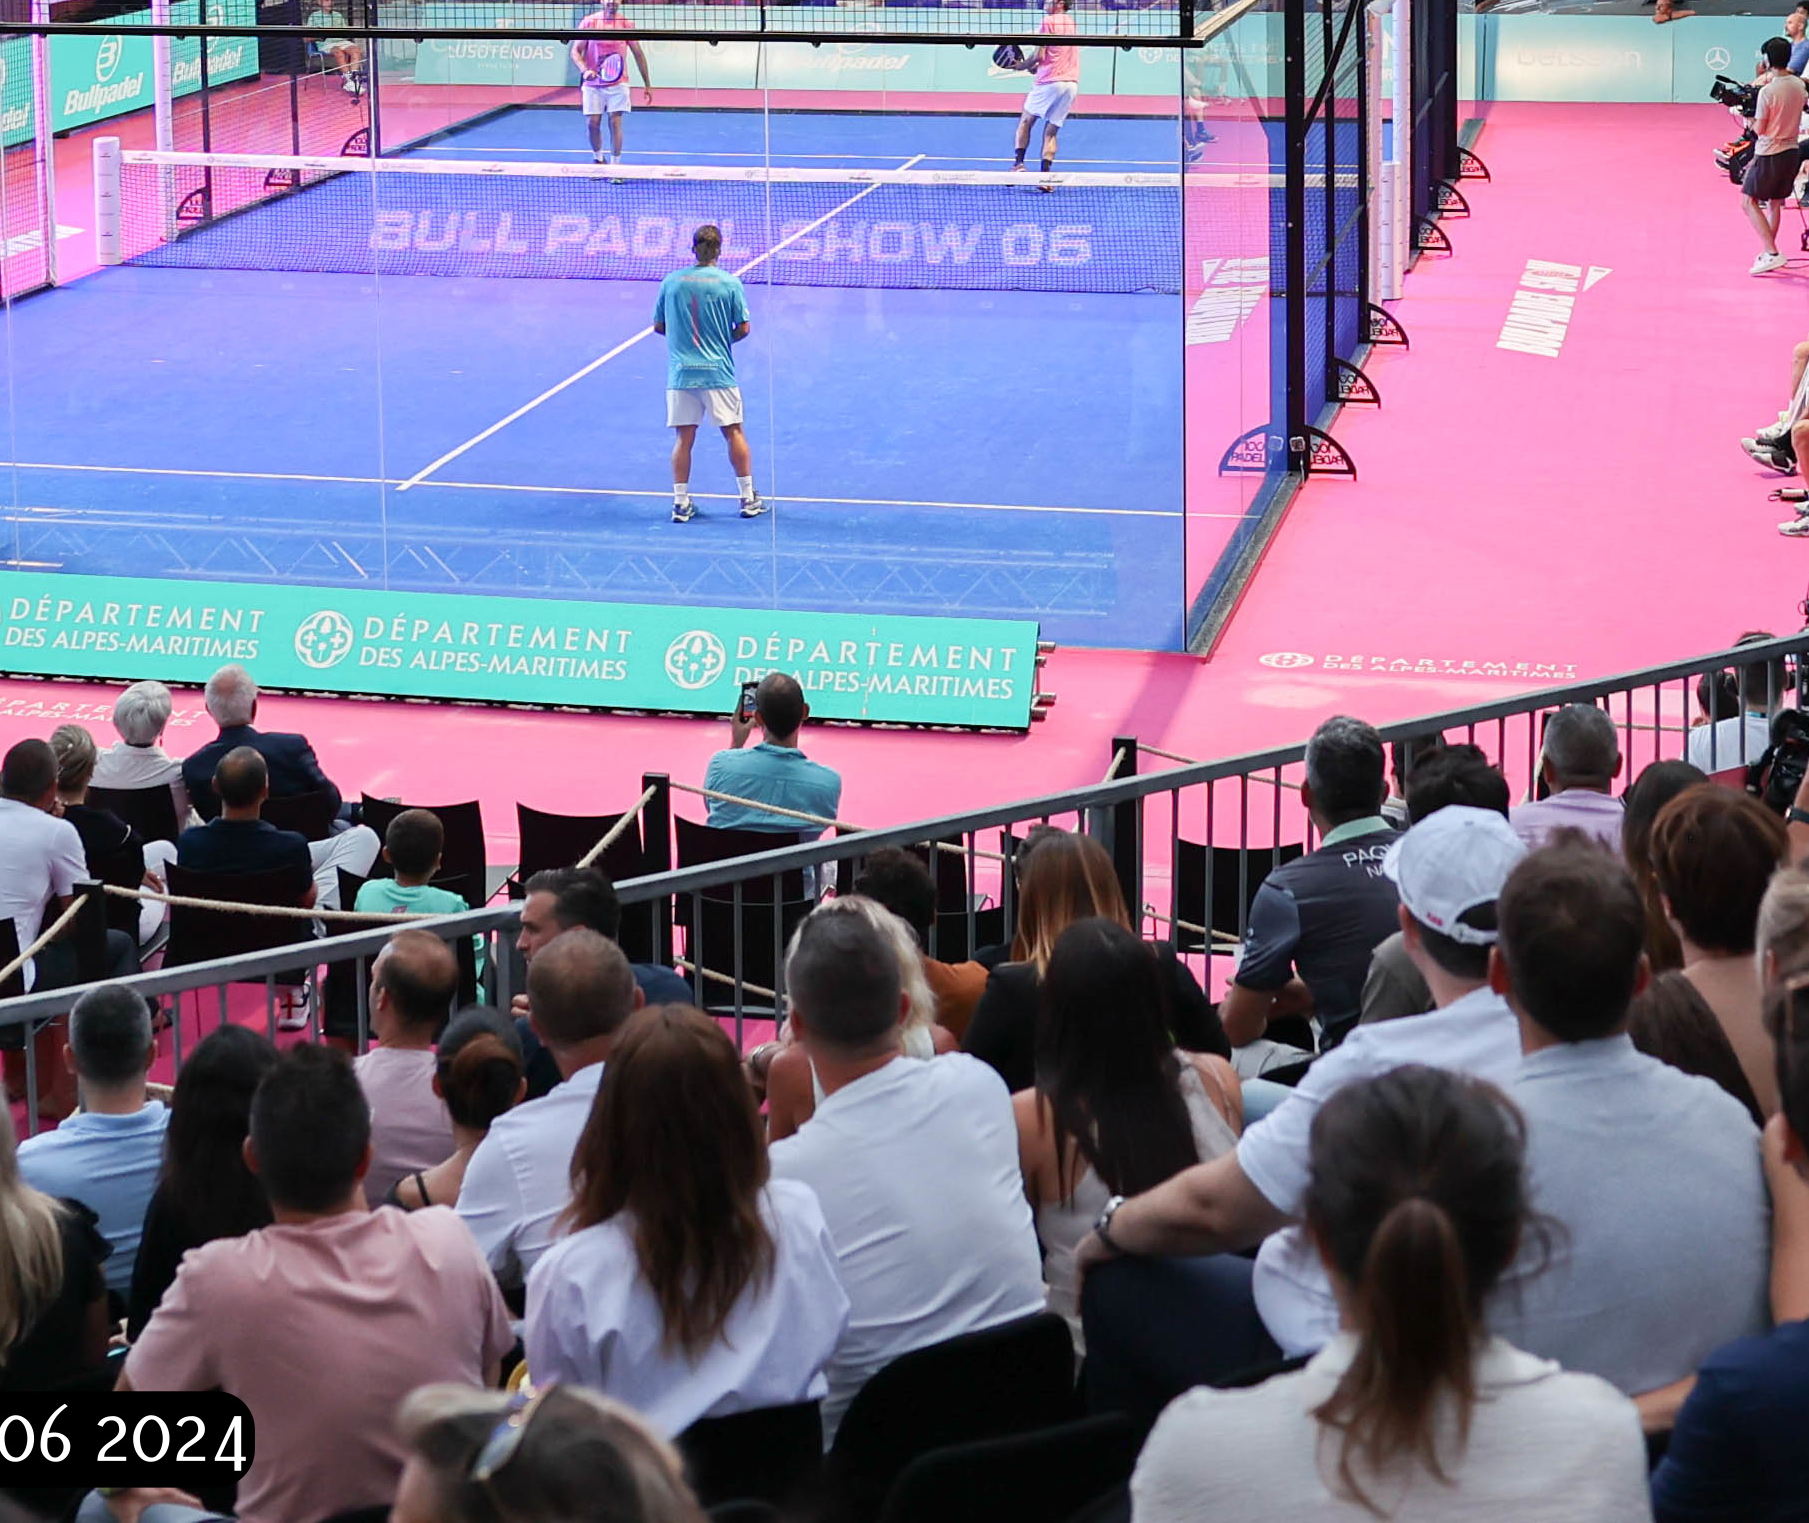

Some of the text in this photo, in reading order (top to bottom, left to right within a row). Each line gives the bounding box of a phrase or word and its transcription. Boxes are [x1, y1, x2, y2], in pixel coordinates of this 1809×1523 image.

[63, 72, 144, 117] Bullpadel
[369, 208, 535, 255] BULL
[776, 216, 984, 265] SHOW
[999, 222, 1094, 267] 06
[11, 593, 266, 633] DÉPARTEMENT
[364, 612, 634, 654] DÉPARTEMENT
[4, 624, 261, 661] DES ALPES-MARITIMES
[358, 643, 629, 681] DES ALPES-MARITIMES
[737, 632, 1019, 672] DÉPARTEMENT
